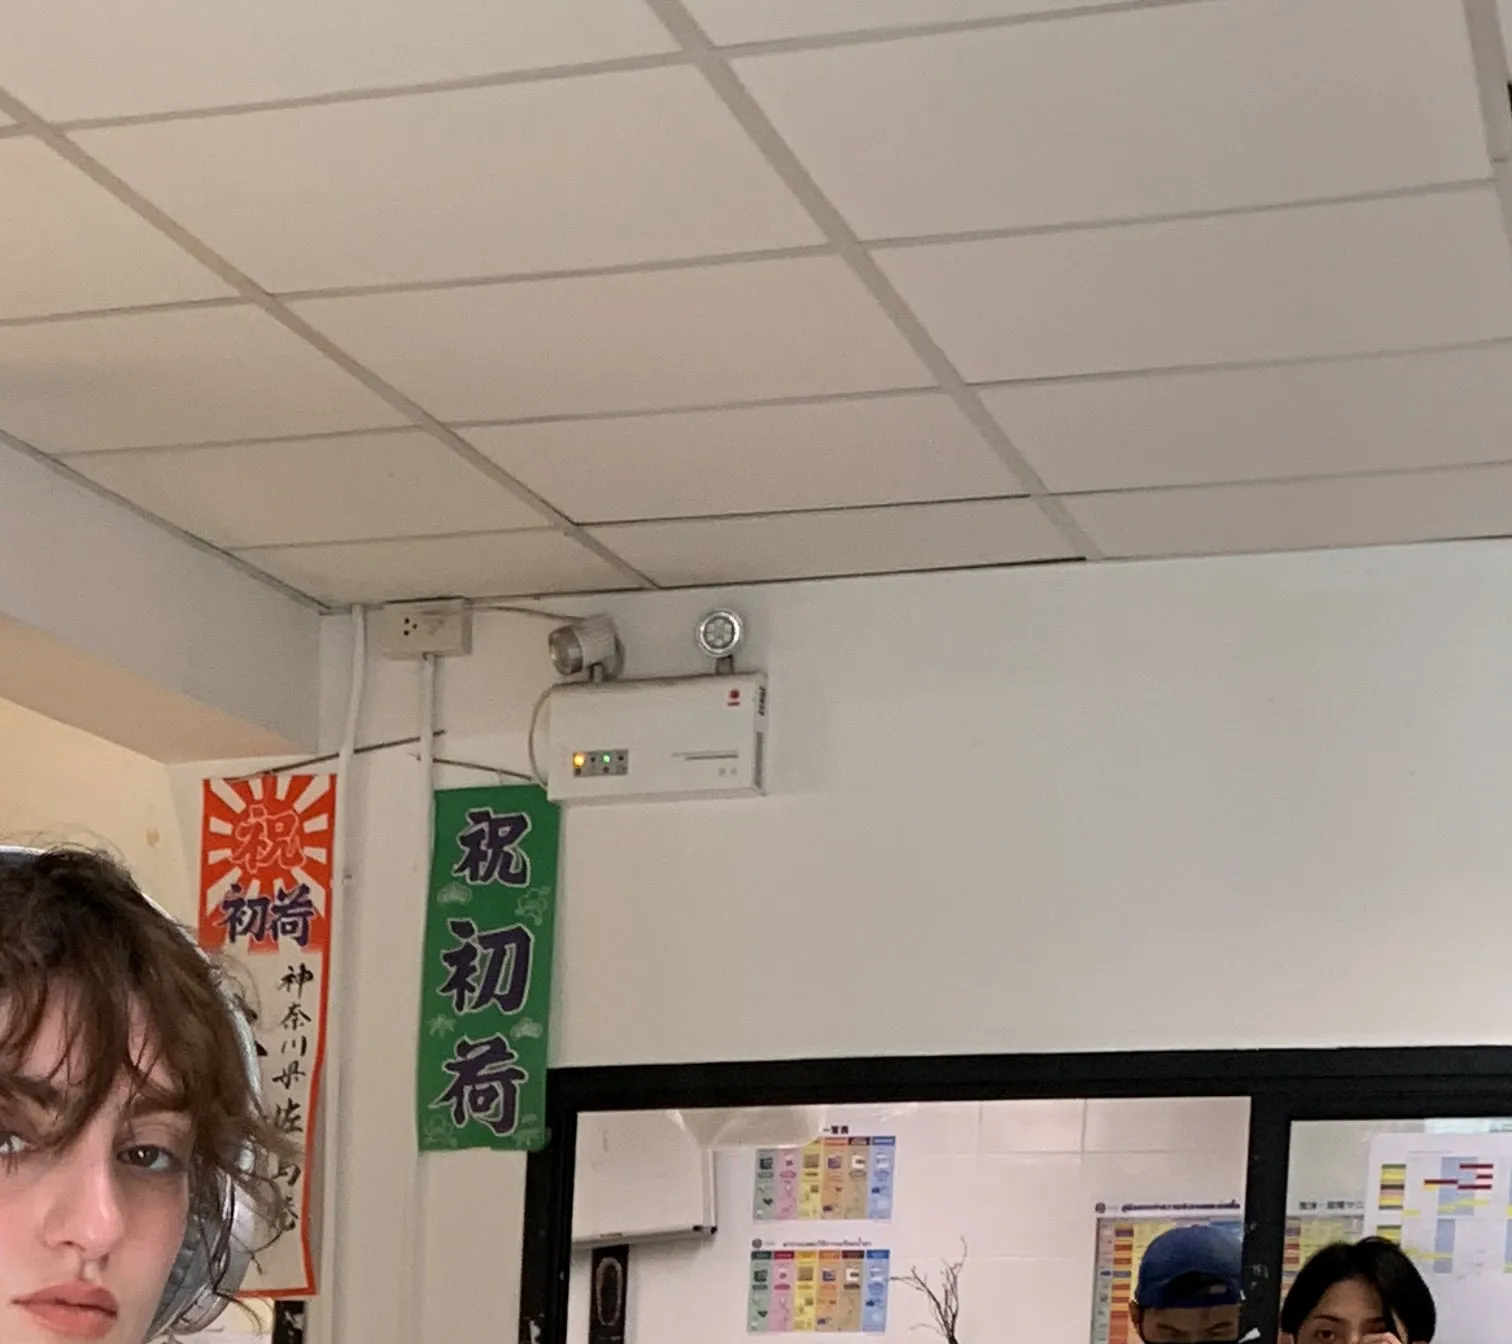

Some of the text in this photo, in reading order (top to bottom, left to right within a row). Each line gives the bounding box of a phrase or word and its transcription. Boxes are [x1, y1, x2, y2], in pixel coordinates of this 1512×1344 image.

[213, 882, 316, 947] 初荷
[429, 806, 535, 1137] 祝初荷
